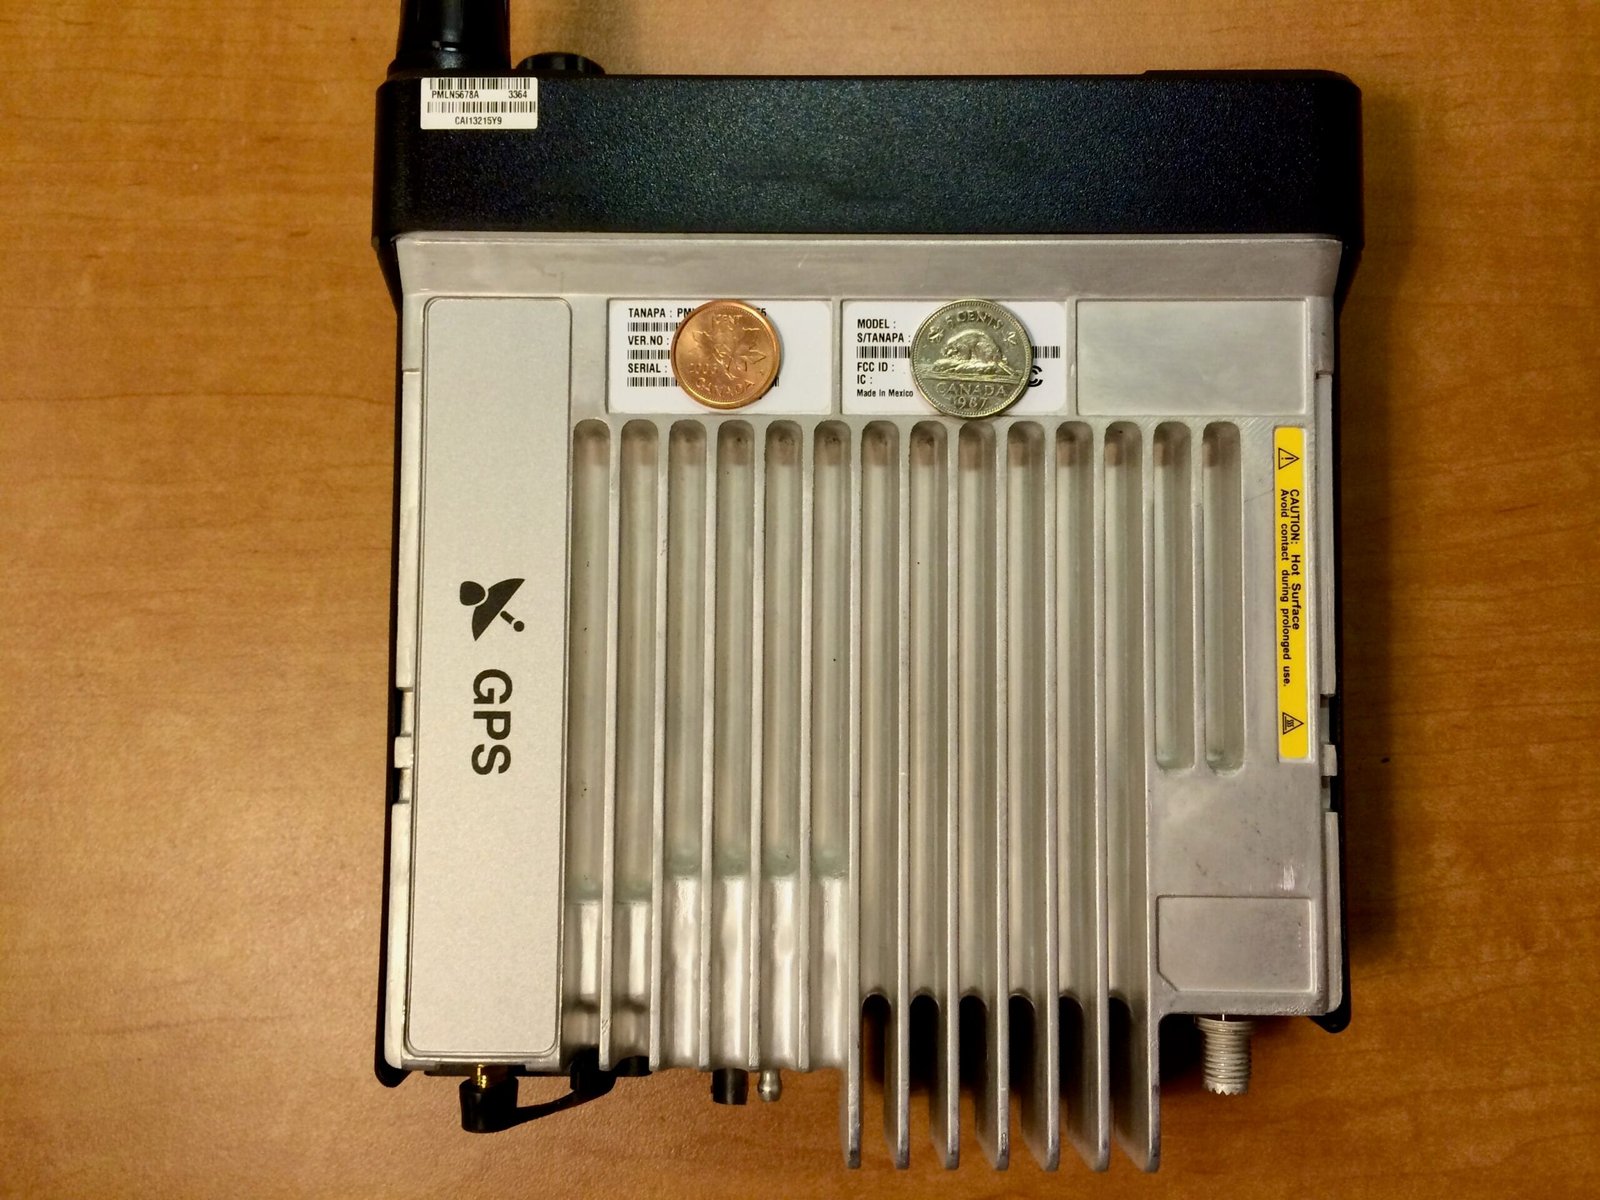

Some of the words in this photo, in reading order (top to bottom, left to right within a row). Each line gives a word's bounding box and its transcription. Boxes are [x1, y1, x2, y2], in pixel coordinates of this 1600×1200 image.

[431, 90, 480, 99] PMLN5678A
[508, 90, 528, 99] 3364
[454, 116, 503, 125] CAI13215Y9
[629, 308, 666, 318] TANAPA
[956, 309, 1004, 330] CENTS
[857, 319, 890, 329] MODEL
[628, 336, 663, 346] VER.NO
[857, 333, 905, 343] S/TANAPA
[628, 364, 661, 373] SERIAL
[857, 362, 875, 372] FCC
[878, 362, 888, 372] ID
[857, 375, 867, 385] IC
[857, 389, 877, 398] Made
[888, 389, 914, 398] Mexico
[936, 382, 1009, 398] CANADA
[1280, 489, 1290, 518] Avoid
[1290, 489, 1301, 545] CAUTION:
[1281, 523, 1290, 561] contact
[1291, 554, 1301, 576] Hot
[1280, 569, 1291, 603] during
[1291, 583, 1302, 631] Surface
[1280, 608, 1292, 661] prolonged
[1283, 666, 1291, 687] use.
[471, 668, 513, 775] GPS
